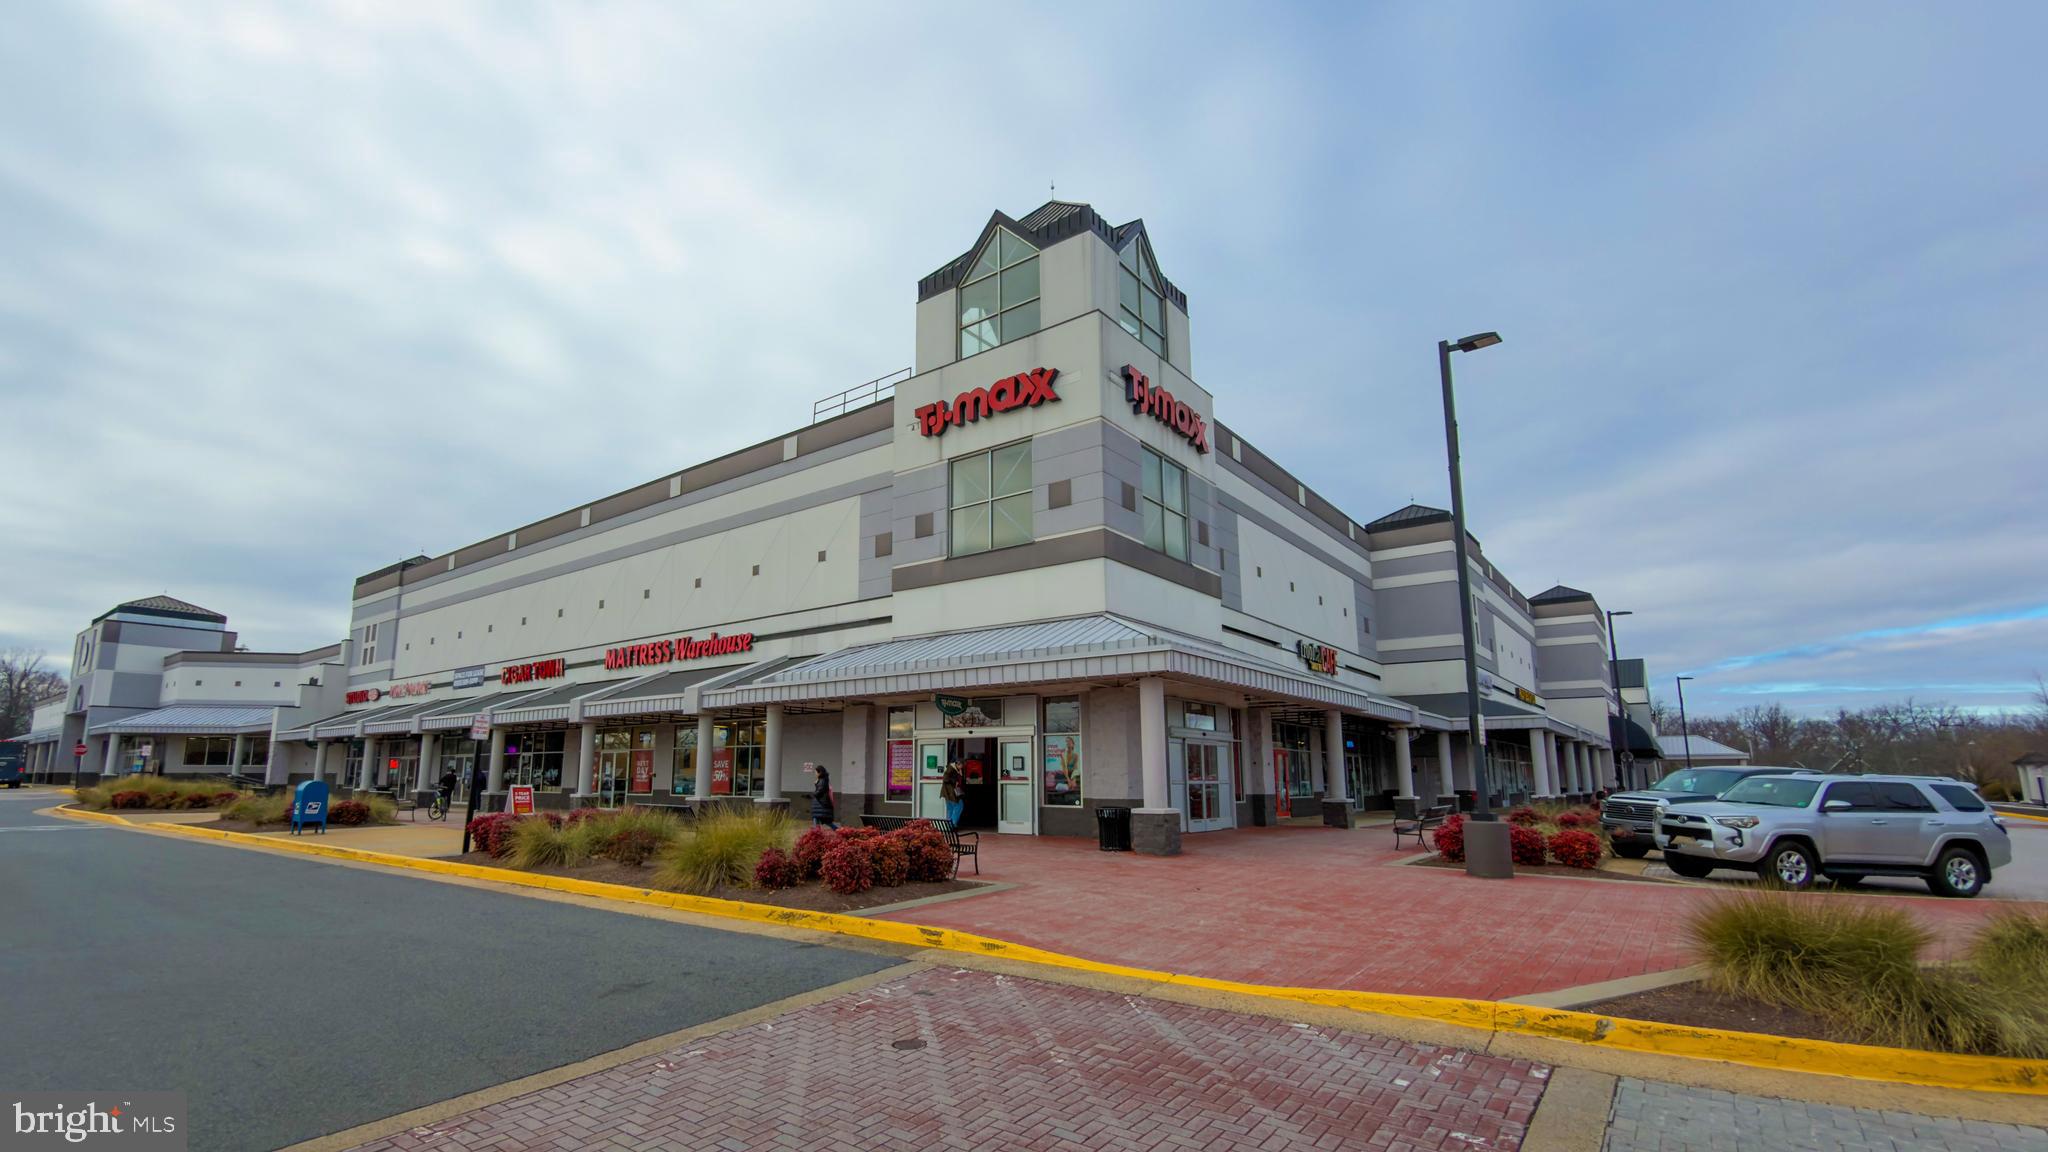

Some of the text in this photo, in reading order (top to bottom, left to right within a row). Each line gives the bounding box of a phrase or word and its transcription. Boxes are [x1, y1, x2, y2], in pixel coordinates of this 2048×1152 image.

[604, 632, 754, 671] MATTRESS Warehouse
[501, 664, 532, 685] CIGAR
[532, 658, 565, 680] TOWN
[636, 766, 649, 774] DAY
[713, 760, 729, 768] SAVE
[712, 769, 729, 782] 50%
